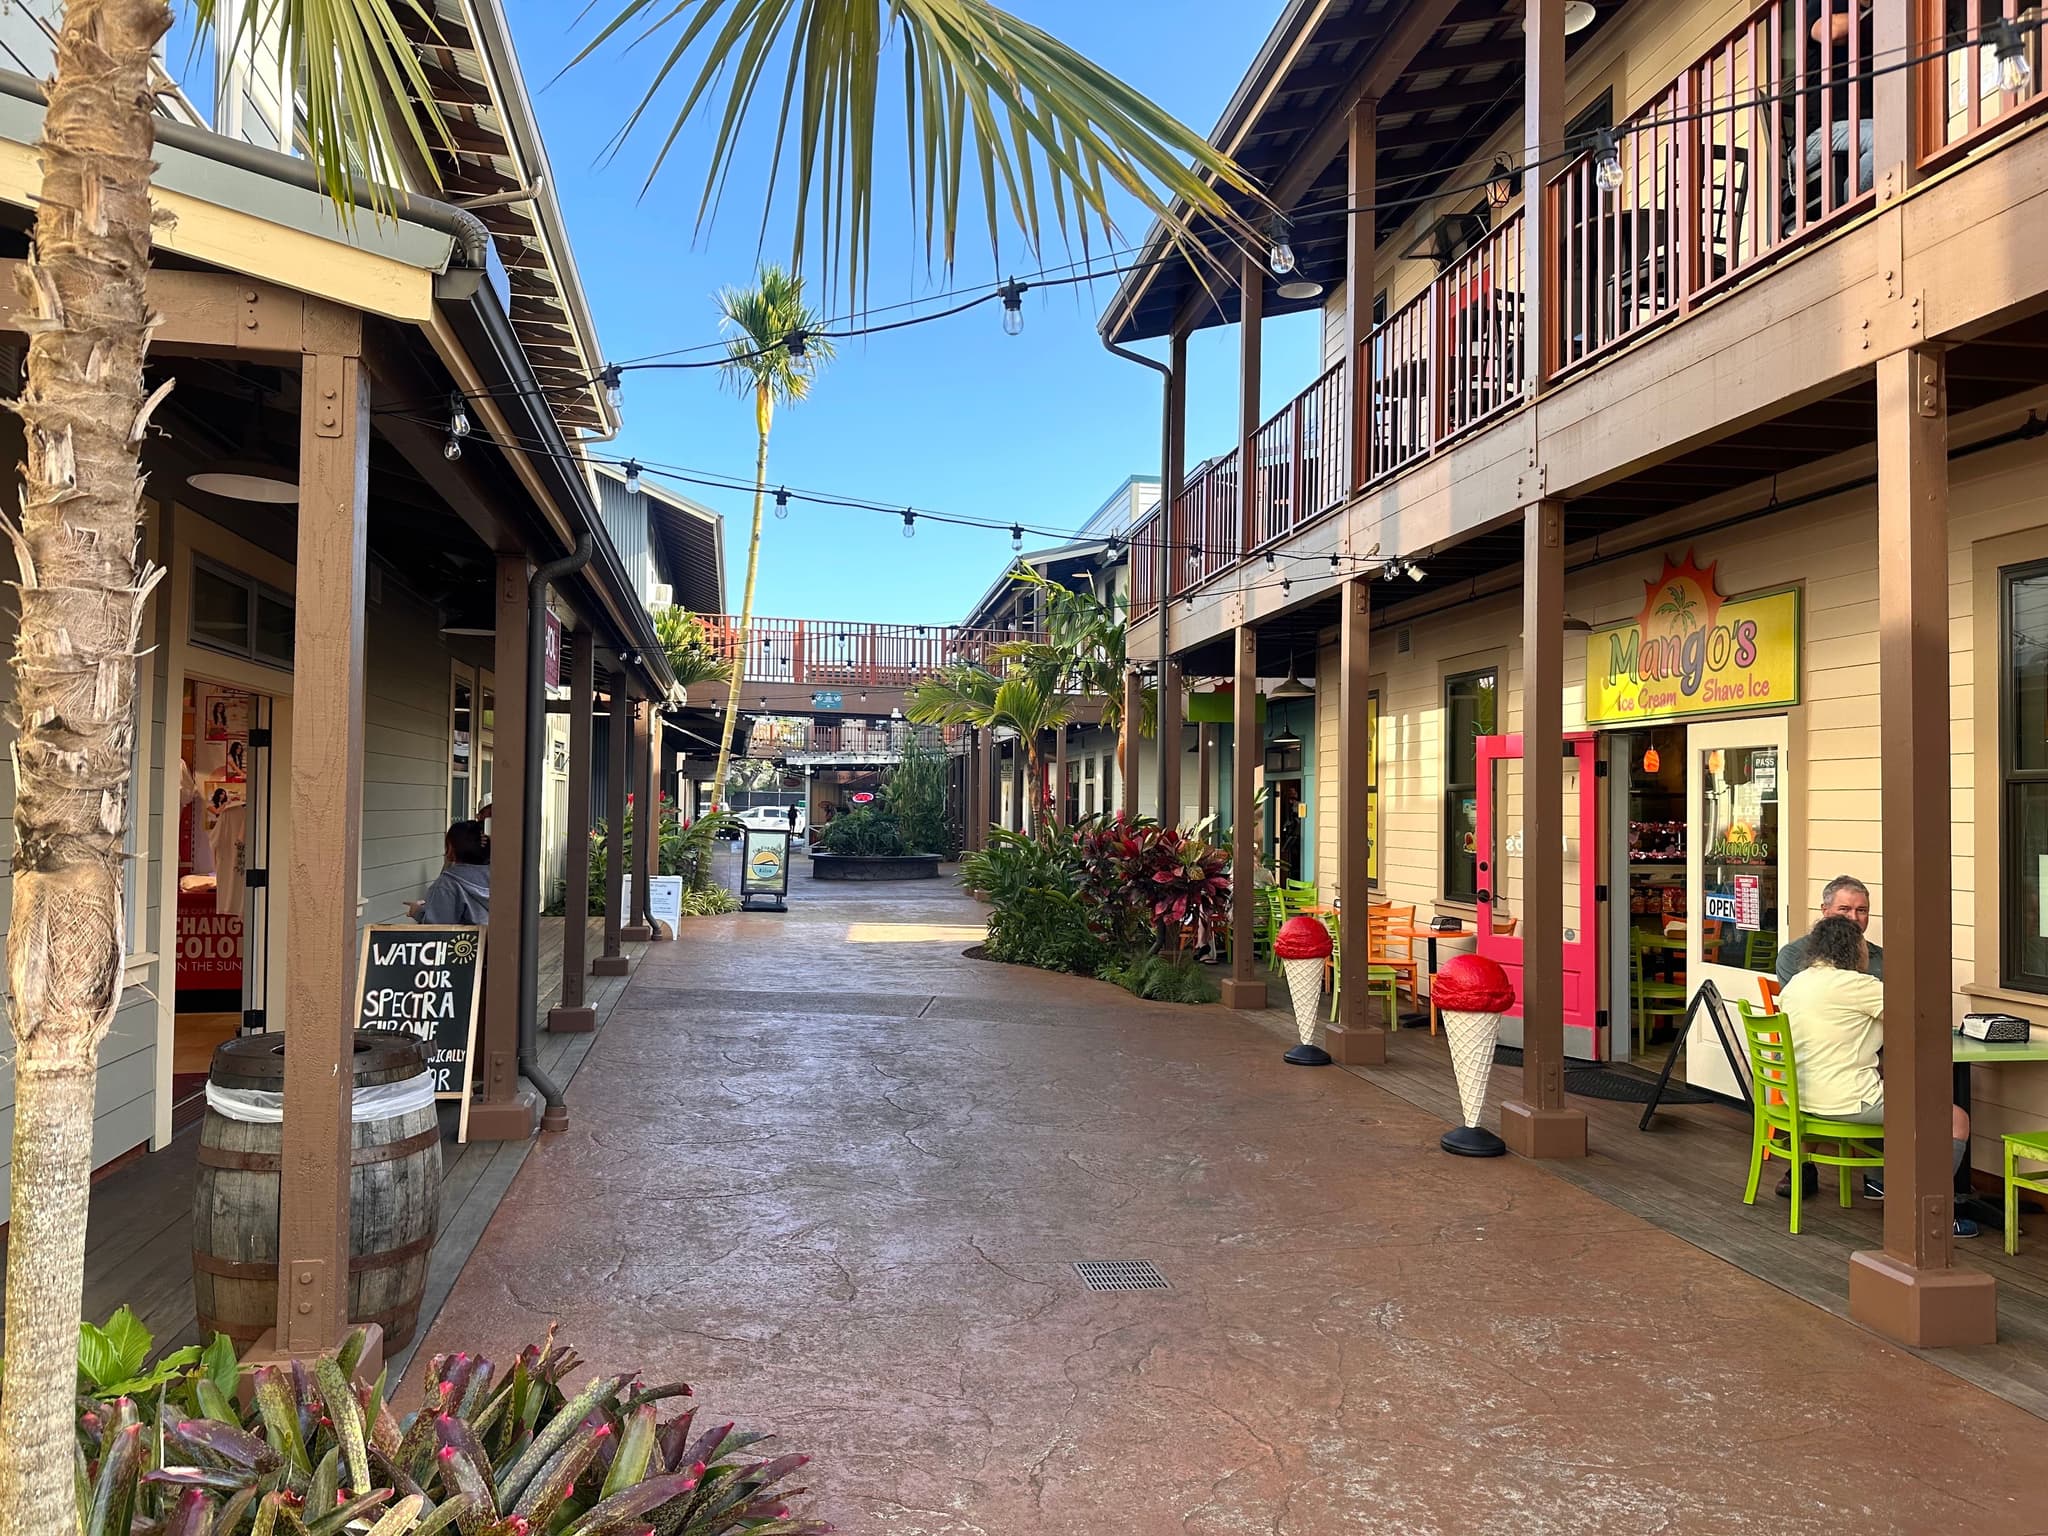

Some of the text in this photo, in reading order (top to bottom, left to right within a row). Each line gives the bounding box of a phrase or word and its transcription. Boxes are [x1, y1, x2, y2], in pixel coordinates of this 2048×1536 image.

[1609, 619, 1757, 696] Mango's
[1617, 673, 1770, 712] Ice Cream Shave Ice
[1755, 758, 1775, 767] PASS
[1714, 838, 1768, 863] Mango's
[1709, 899, 1736, 918] OPEN
[177, 917, 243, 935] HANG
[373, 941, 447, 966] WATCH
[192, 962, 213, 971] THE
[217, 961, 242, 971] SUN
[414, 970, 453, 988] OUR
[363, 989, 455, 1019] SPECTRA
